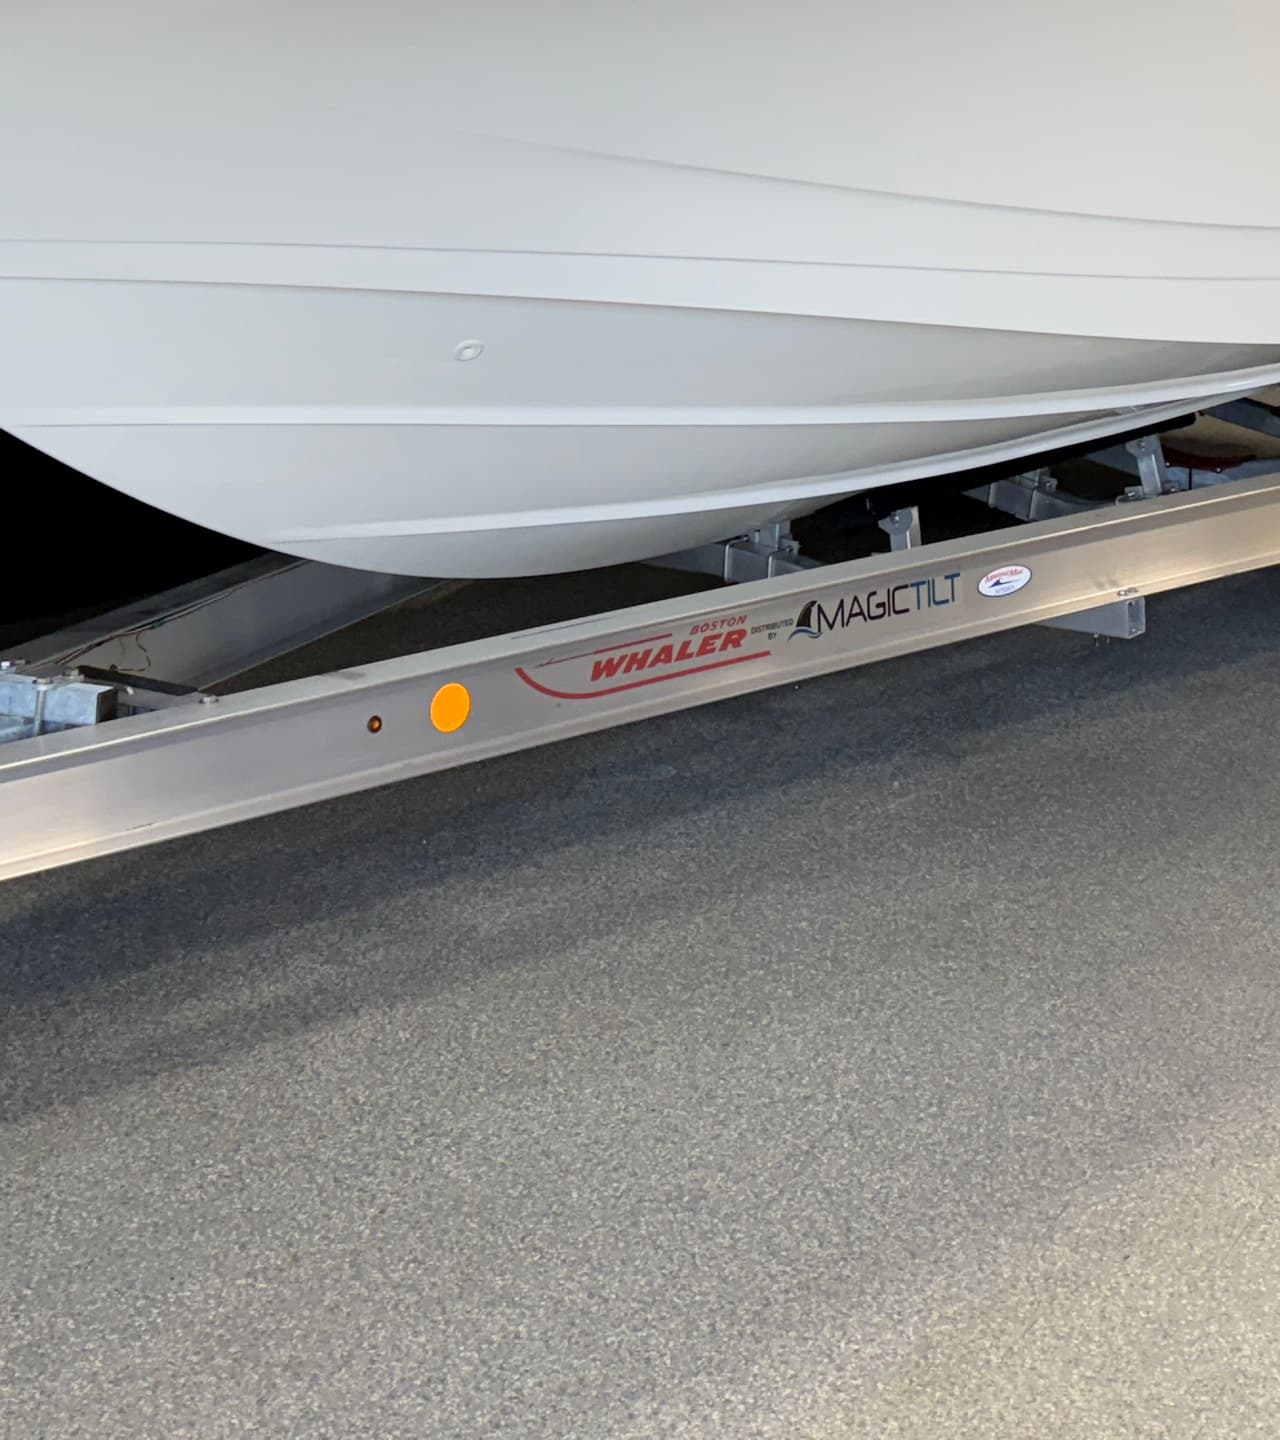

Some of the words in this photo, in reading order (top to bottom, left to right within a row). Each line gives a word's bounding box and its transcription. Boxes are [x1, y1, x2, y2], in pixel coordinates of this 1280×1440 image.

[817, 572, 961, 634] MAGICTILT
[689, 615, 747, 636] BOSTON
[751, 618, 794, 635] DISTRIBUTED
[590, 629, 748, 682] WHALER
